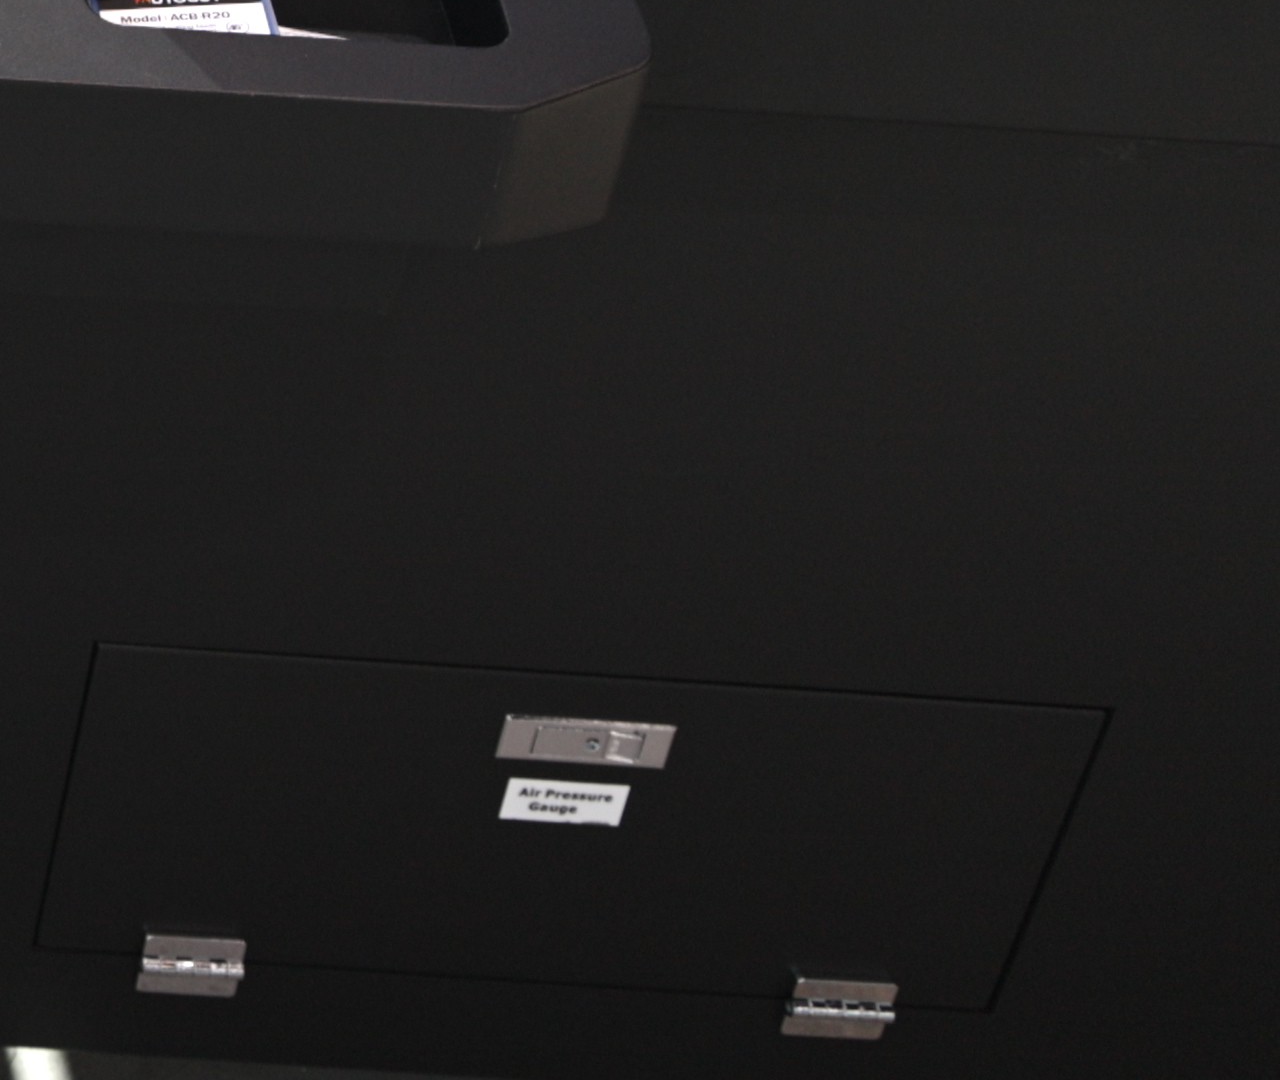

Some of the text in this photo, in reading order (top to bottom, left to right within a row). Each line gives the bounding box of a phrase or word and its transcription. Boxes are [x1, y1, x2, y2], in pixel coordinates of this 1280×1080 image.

[119, 13, 162, 25] Model
[519, 787, 614, 803] Air Pressure
[528, 801, 578, 815] Gauge
